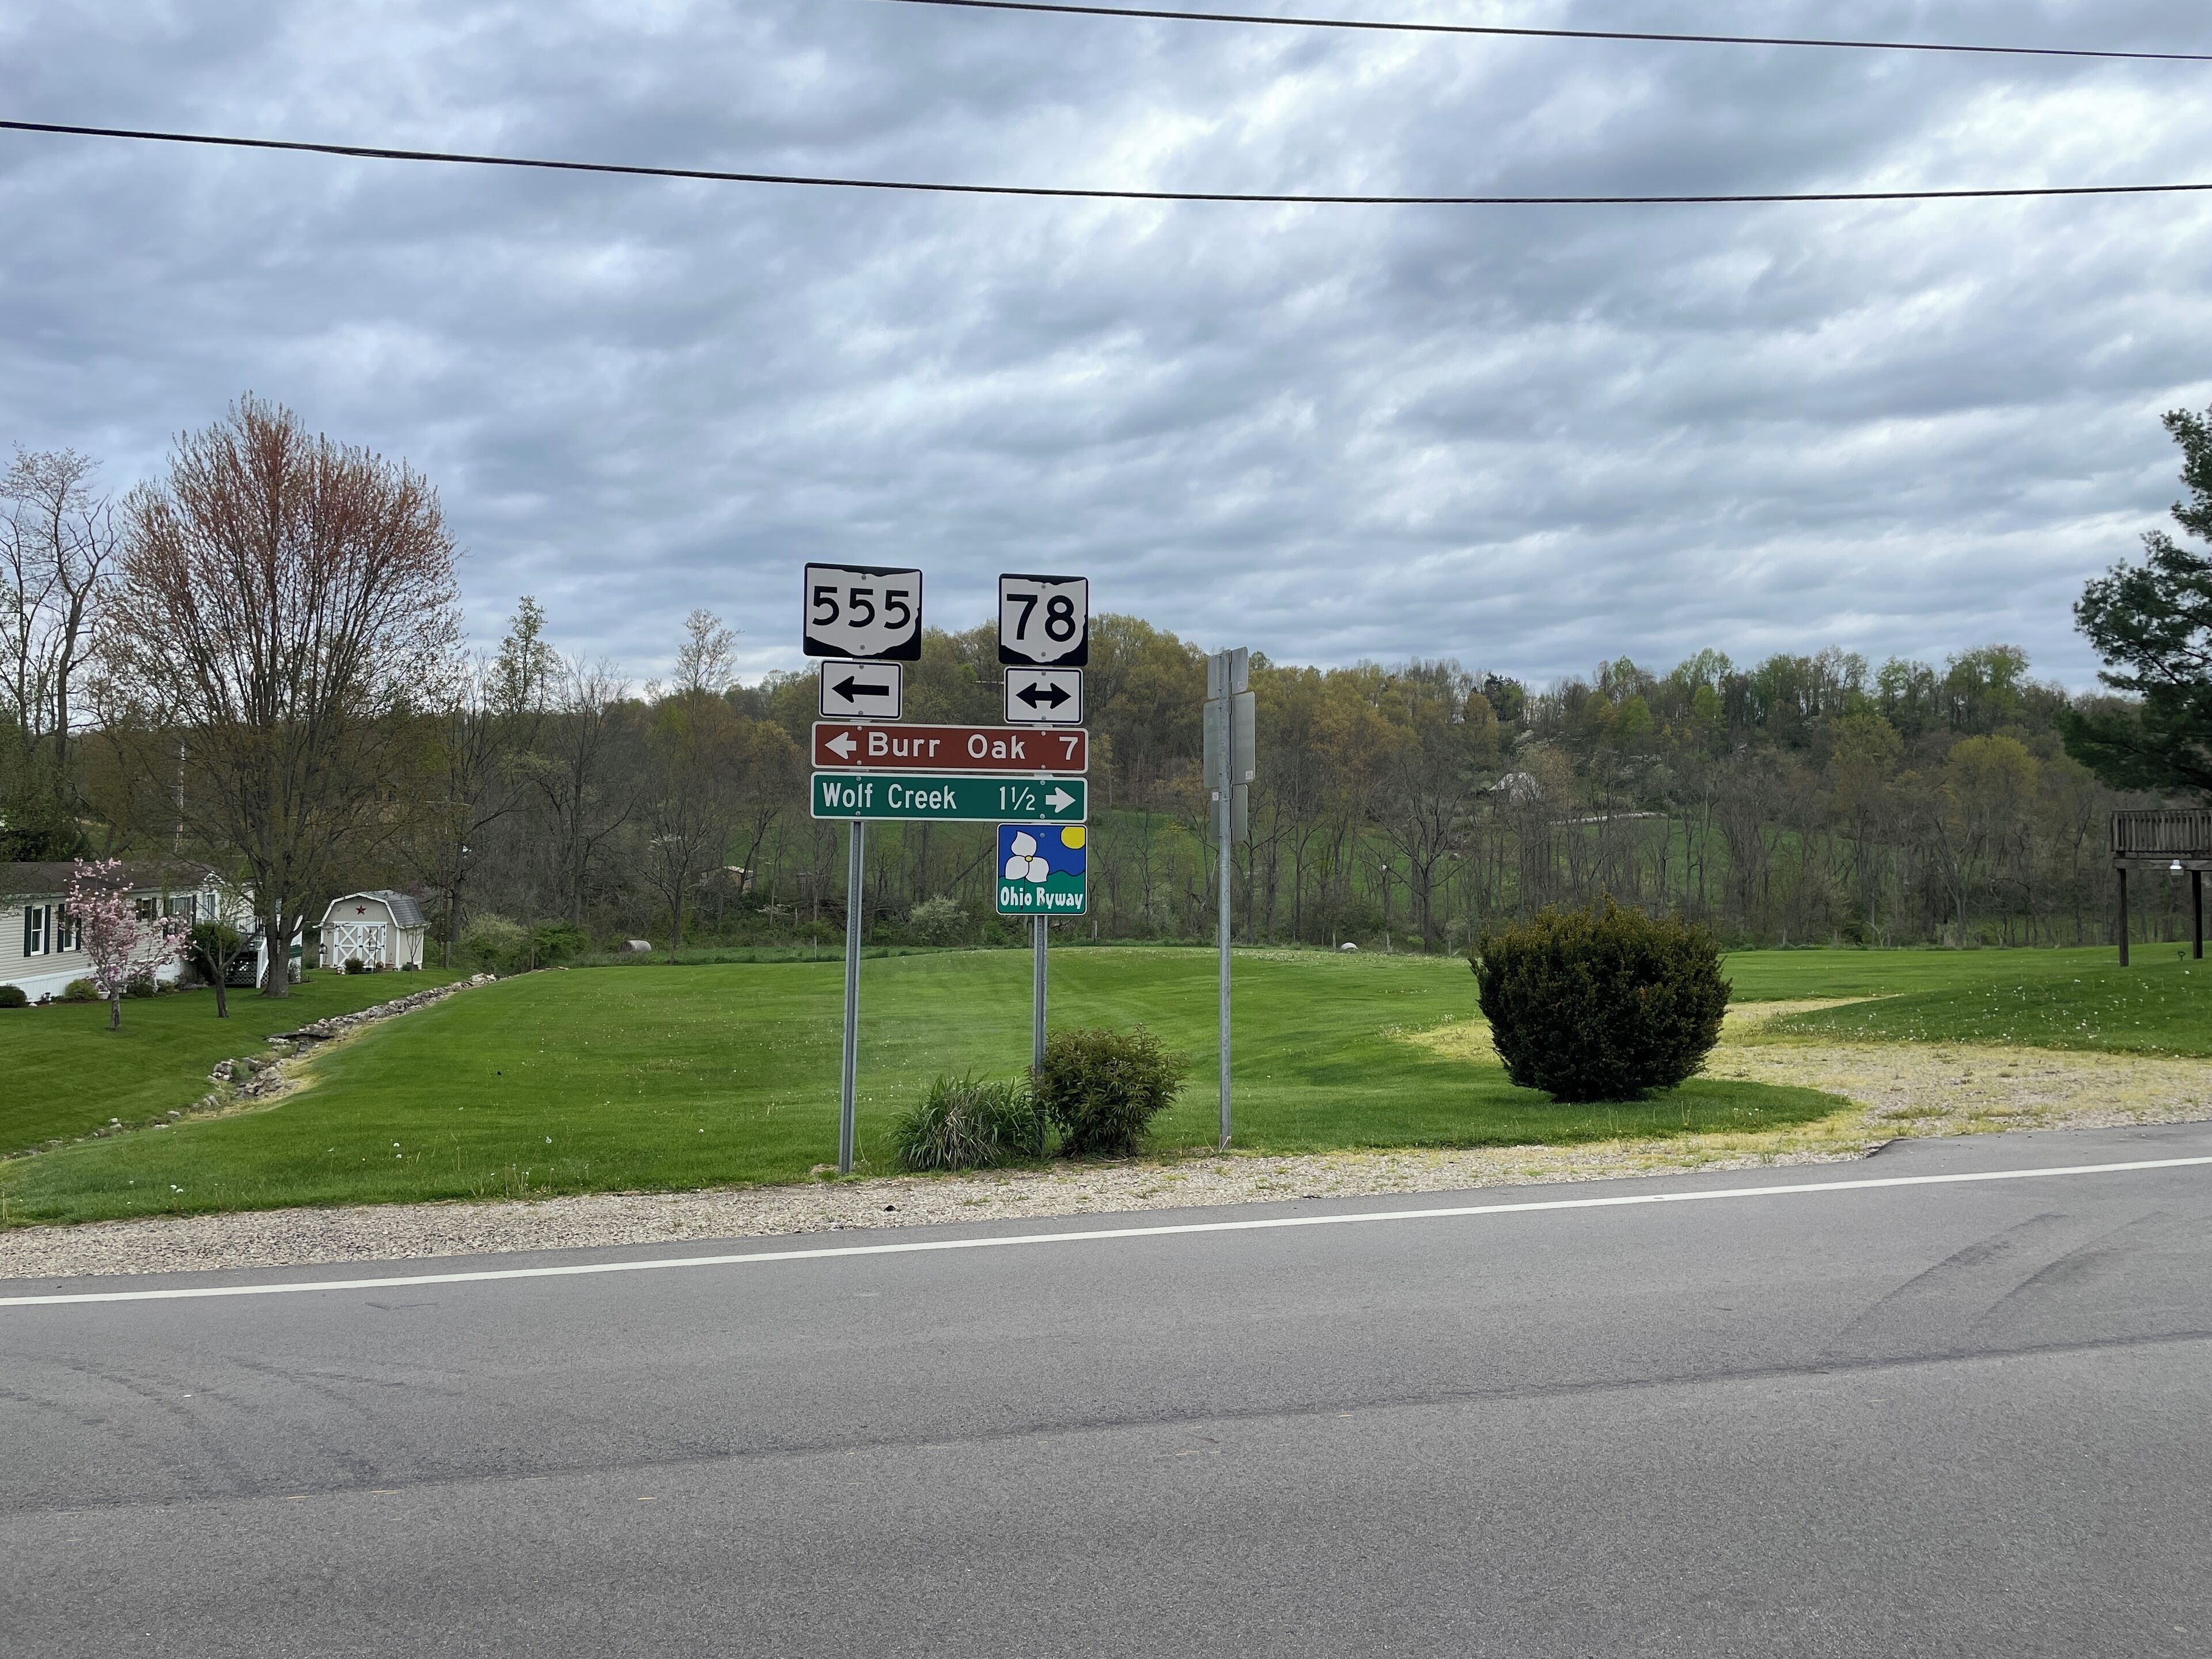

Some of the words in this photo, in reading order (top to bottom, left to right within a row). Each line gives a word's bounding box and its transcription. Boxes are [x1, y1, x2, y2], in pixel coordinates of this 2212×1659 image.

[812, 585, 911, 630] 555
[1006, 593, 1076, 642] 78
[868, 732, 941, 757] Burr
[967, 734, 1025, 760] Oak
[1059, 736, 1078, 760] 7
[823, 782, 873, 808] Wolf
[888, 783, 957, 810] Creek
[1000, 886, 1033, 907] Ohio
[1036, 887, 1084, 910] Byway
